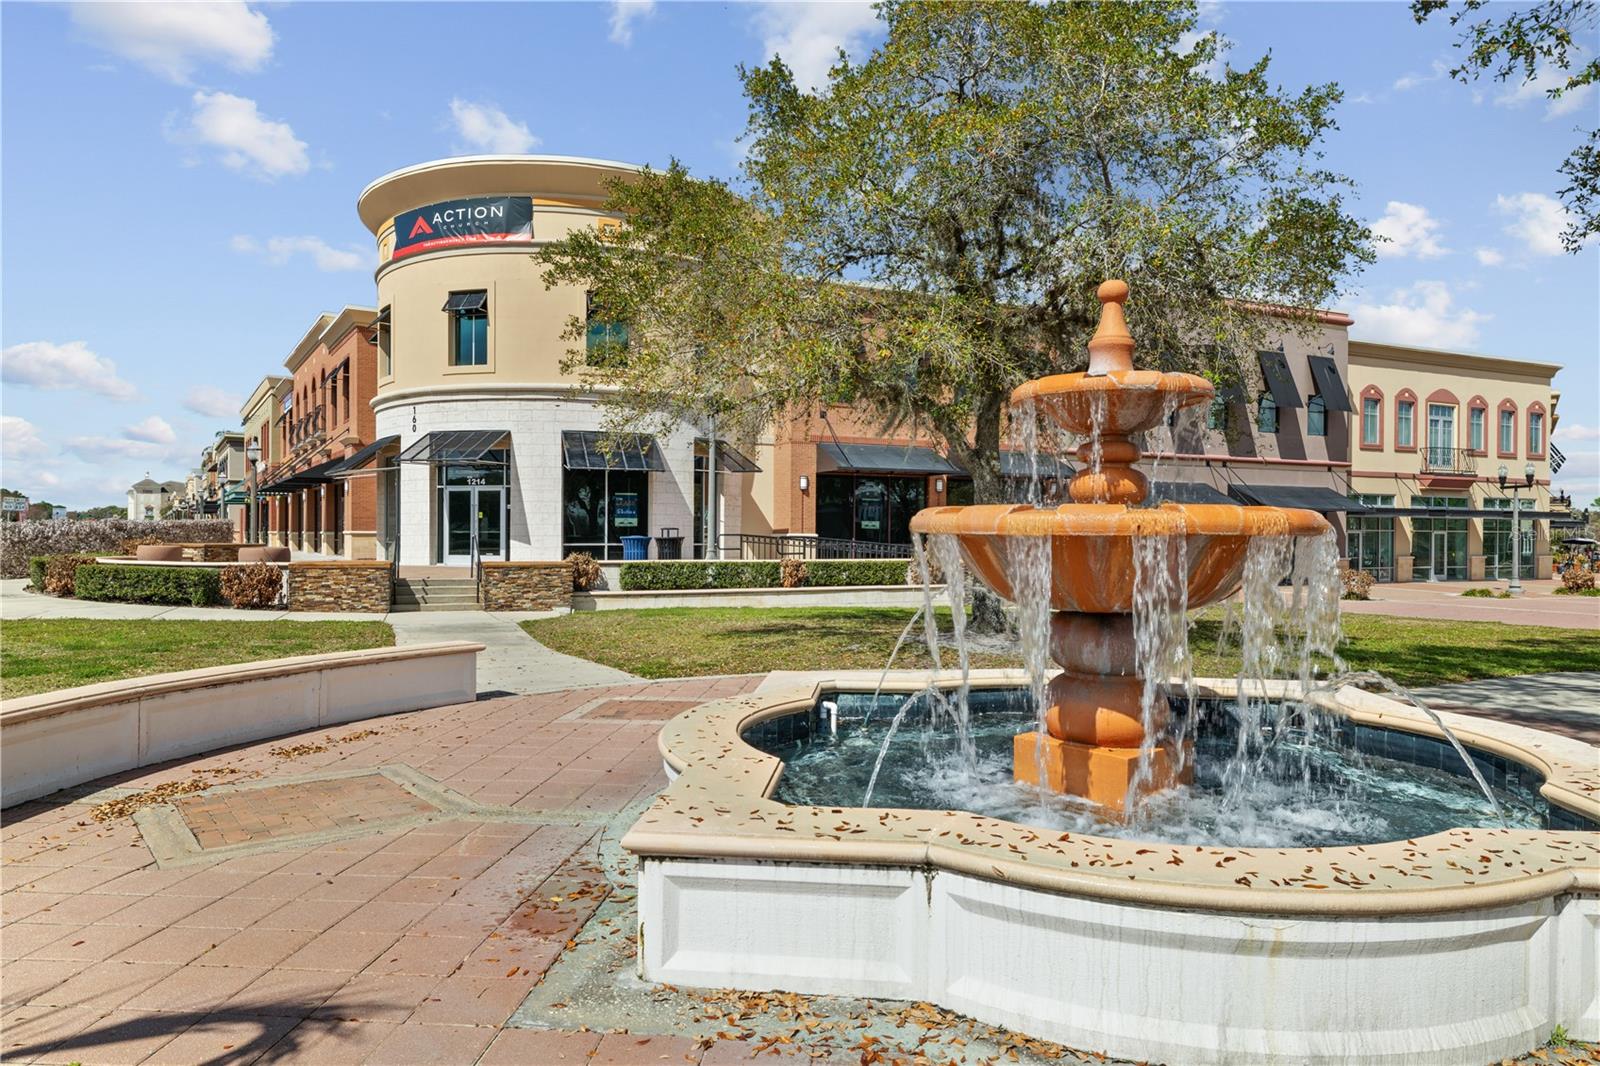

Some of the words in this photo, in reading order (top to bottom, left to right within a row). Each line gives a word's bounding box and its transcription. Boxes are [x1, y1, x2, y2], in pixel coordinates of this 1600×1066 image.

[433, 206, 503, 224] ACTION
[443, 221, 489, 230] CHURCH
[466, 477, 486, 485] 1214
